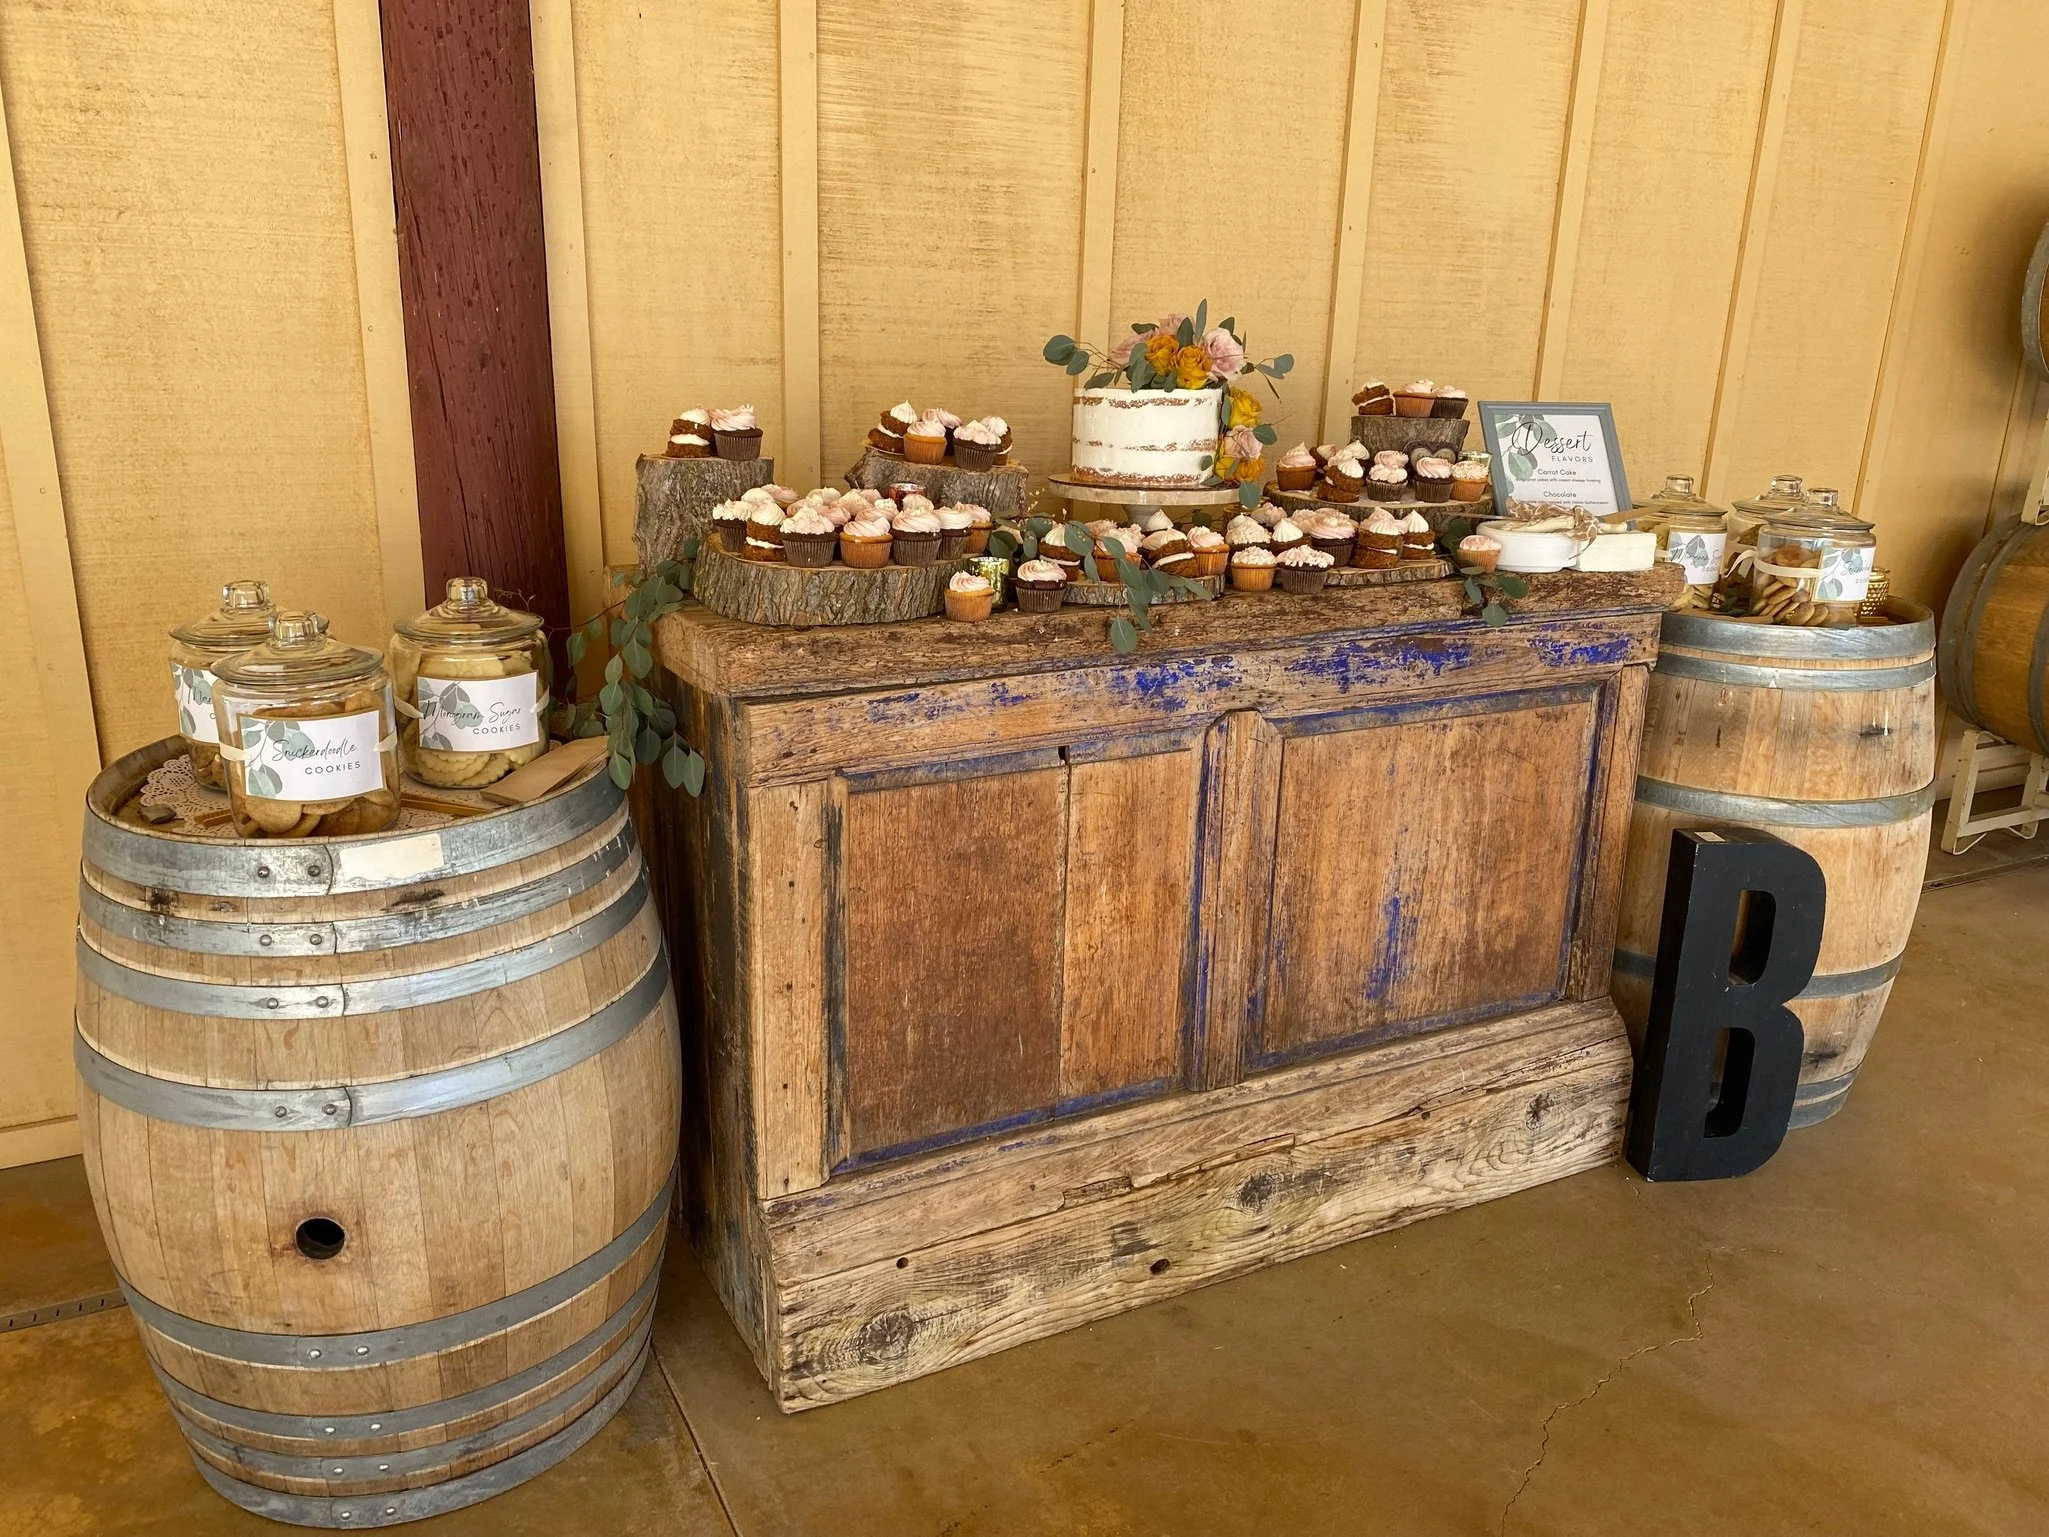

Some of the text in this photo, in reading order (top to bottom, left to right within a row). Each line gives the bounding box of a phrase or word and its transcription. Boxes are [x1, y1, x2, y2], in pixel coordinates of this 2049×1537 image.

[1511, 421, 1594, 457] Dessert
[1551, 455, 1594, 463] FLAVORS
[1537, 468, 1558, 476] Carrot
[1543, 490, 1577, 498] Chocolate
[488, 701, 521, 724] Sugar
[472, 723, 521, 735] COOKIES
[271, 737, 357, 762] Snickerdoodle
[304, 760, 361, 775] COOKIES
[1630, 829, 1827, 1182] B
